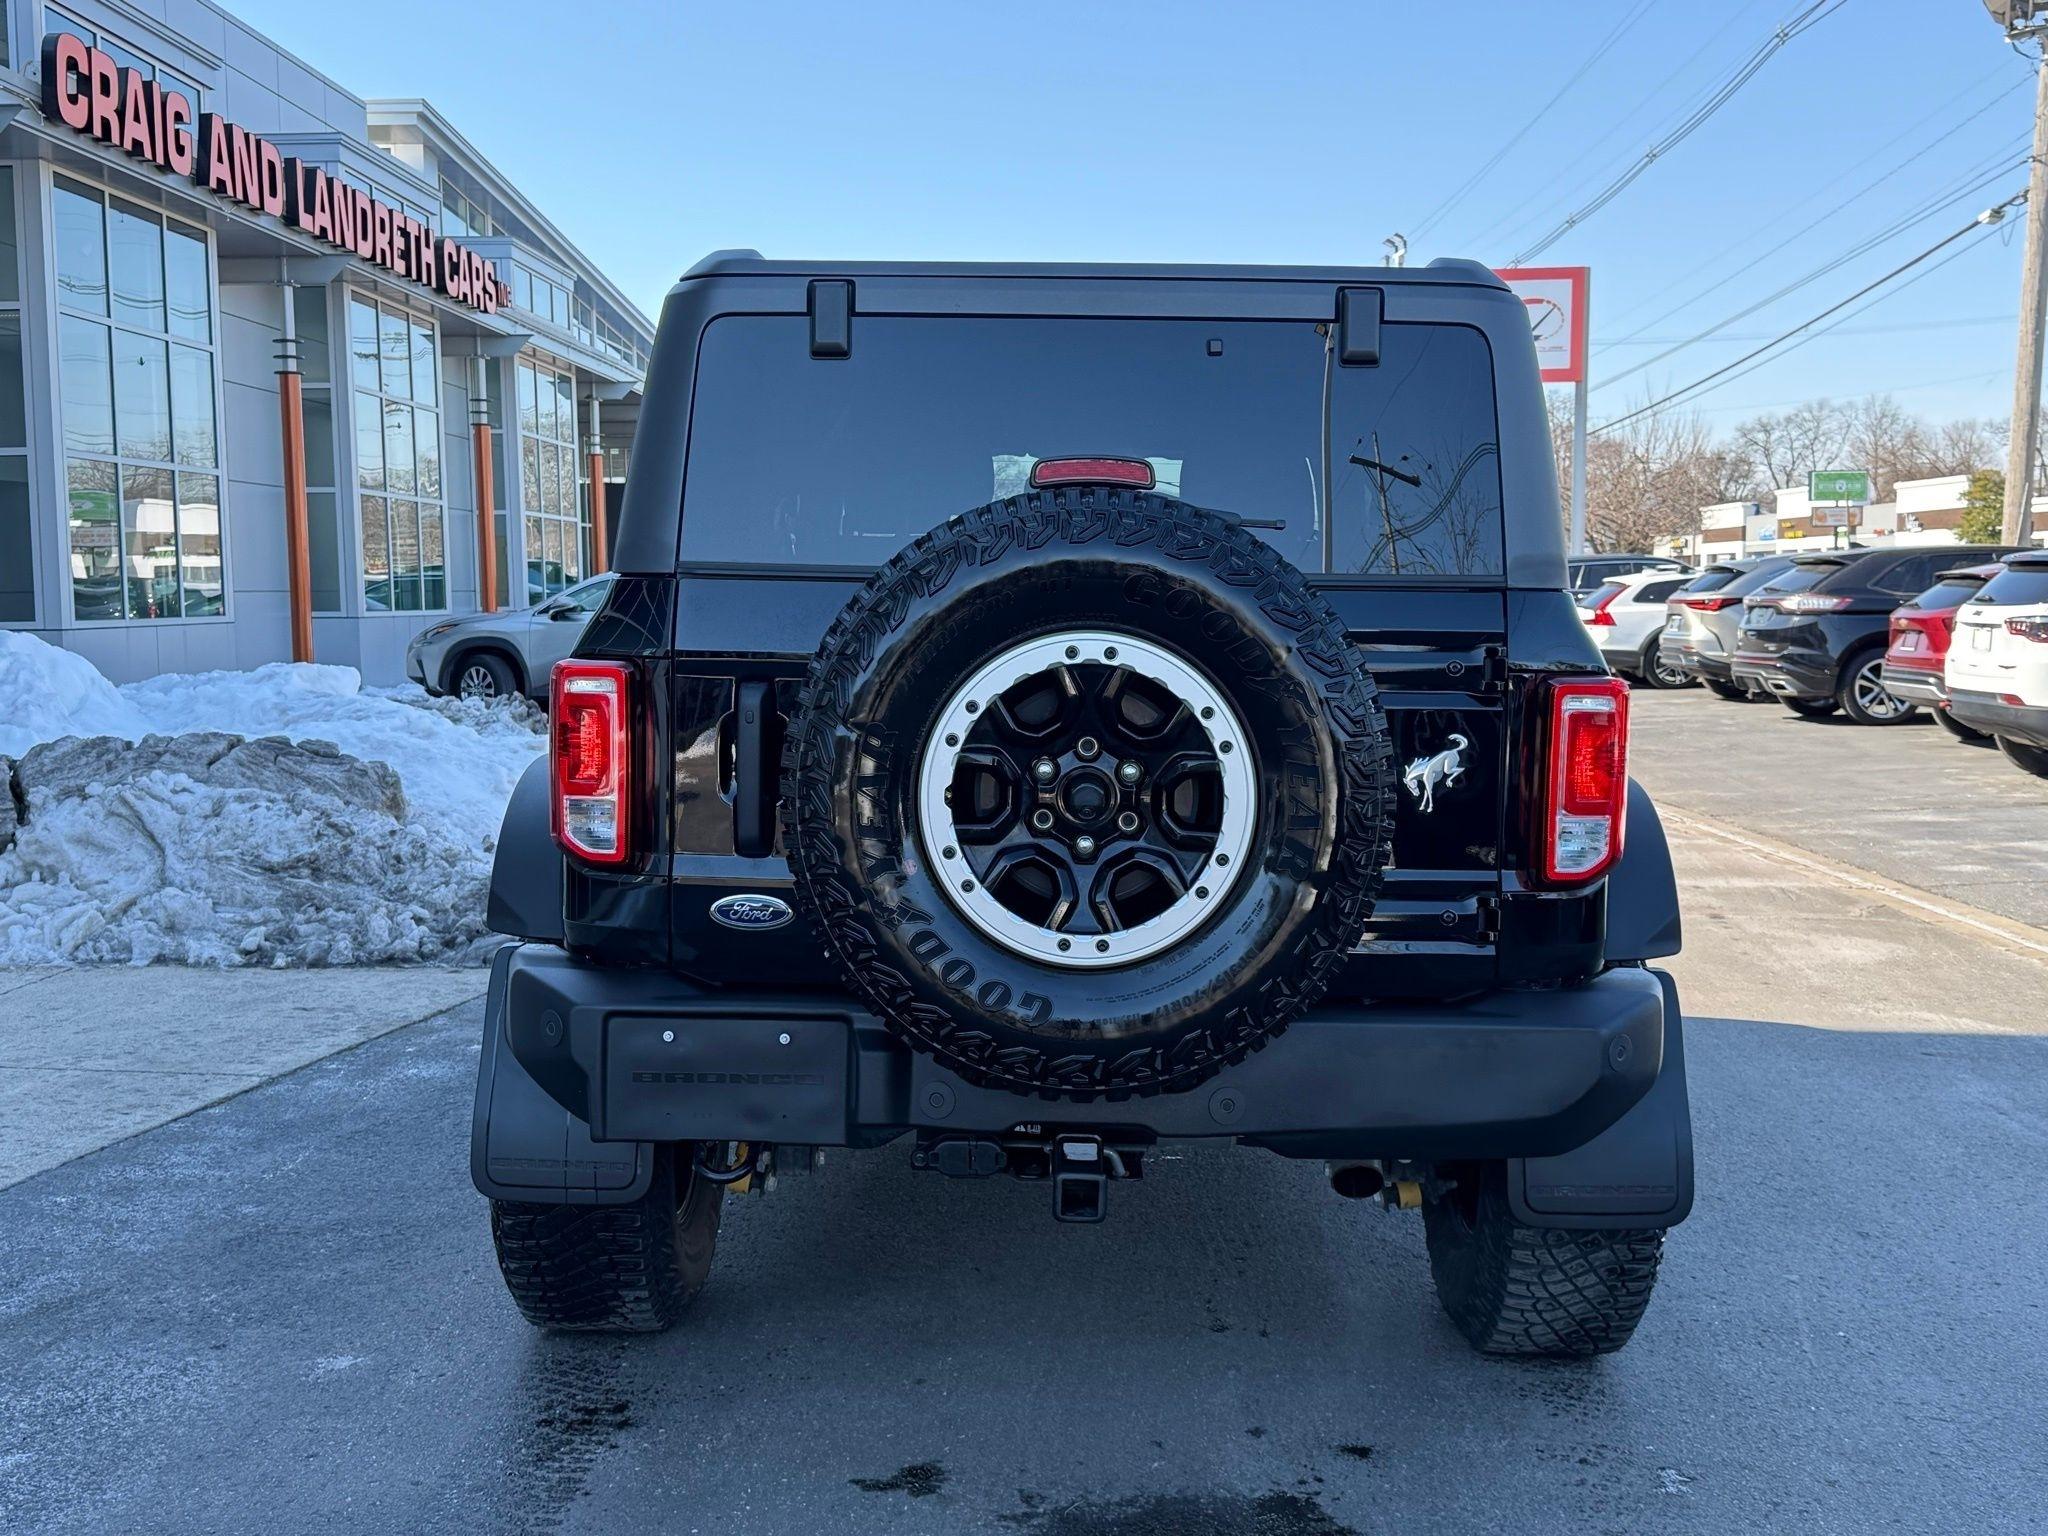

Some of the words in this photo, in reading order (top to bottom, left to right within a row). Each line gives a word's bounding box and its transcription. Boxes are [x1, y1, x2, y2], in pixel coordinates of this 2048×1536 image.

[55, 32, 193, 177] CRAIG
[208, 114, 285, 218] AND
[296, 157, 437, 290] LANDRETH
[443, 237, 498, 315] CARS
[1122, 570, 1324, 885] GOODYEAR
[729, 901, 773, 921] Ford
[855, 721, 1056, 1028] GOODYEAR
[632, 1071, 825, 1086] BRONCO
